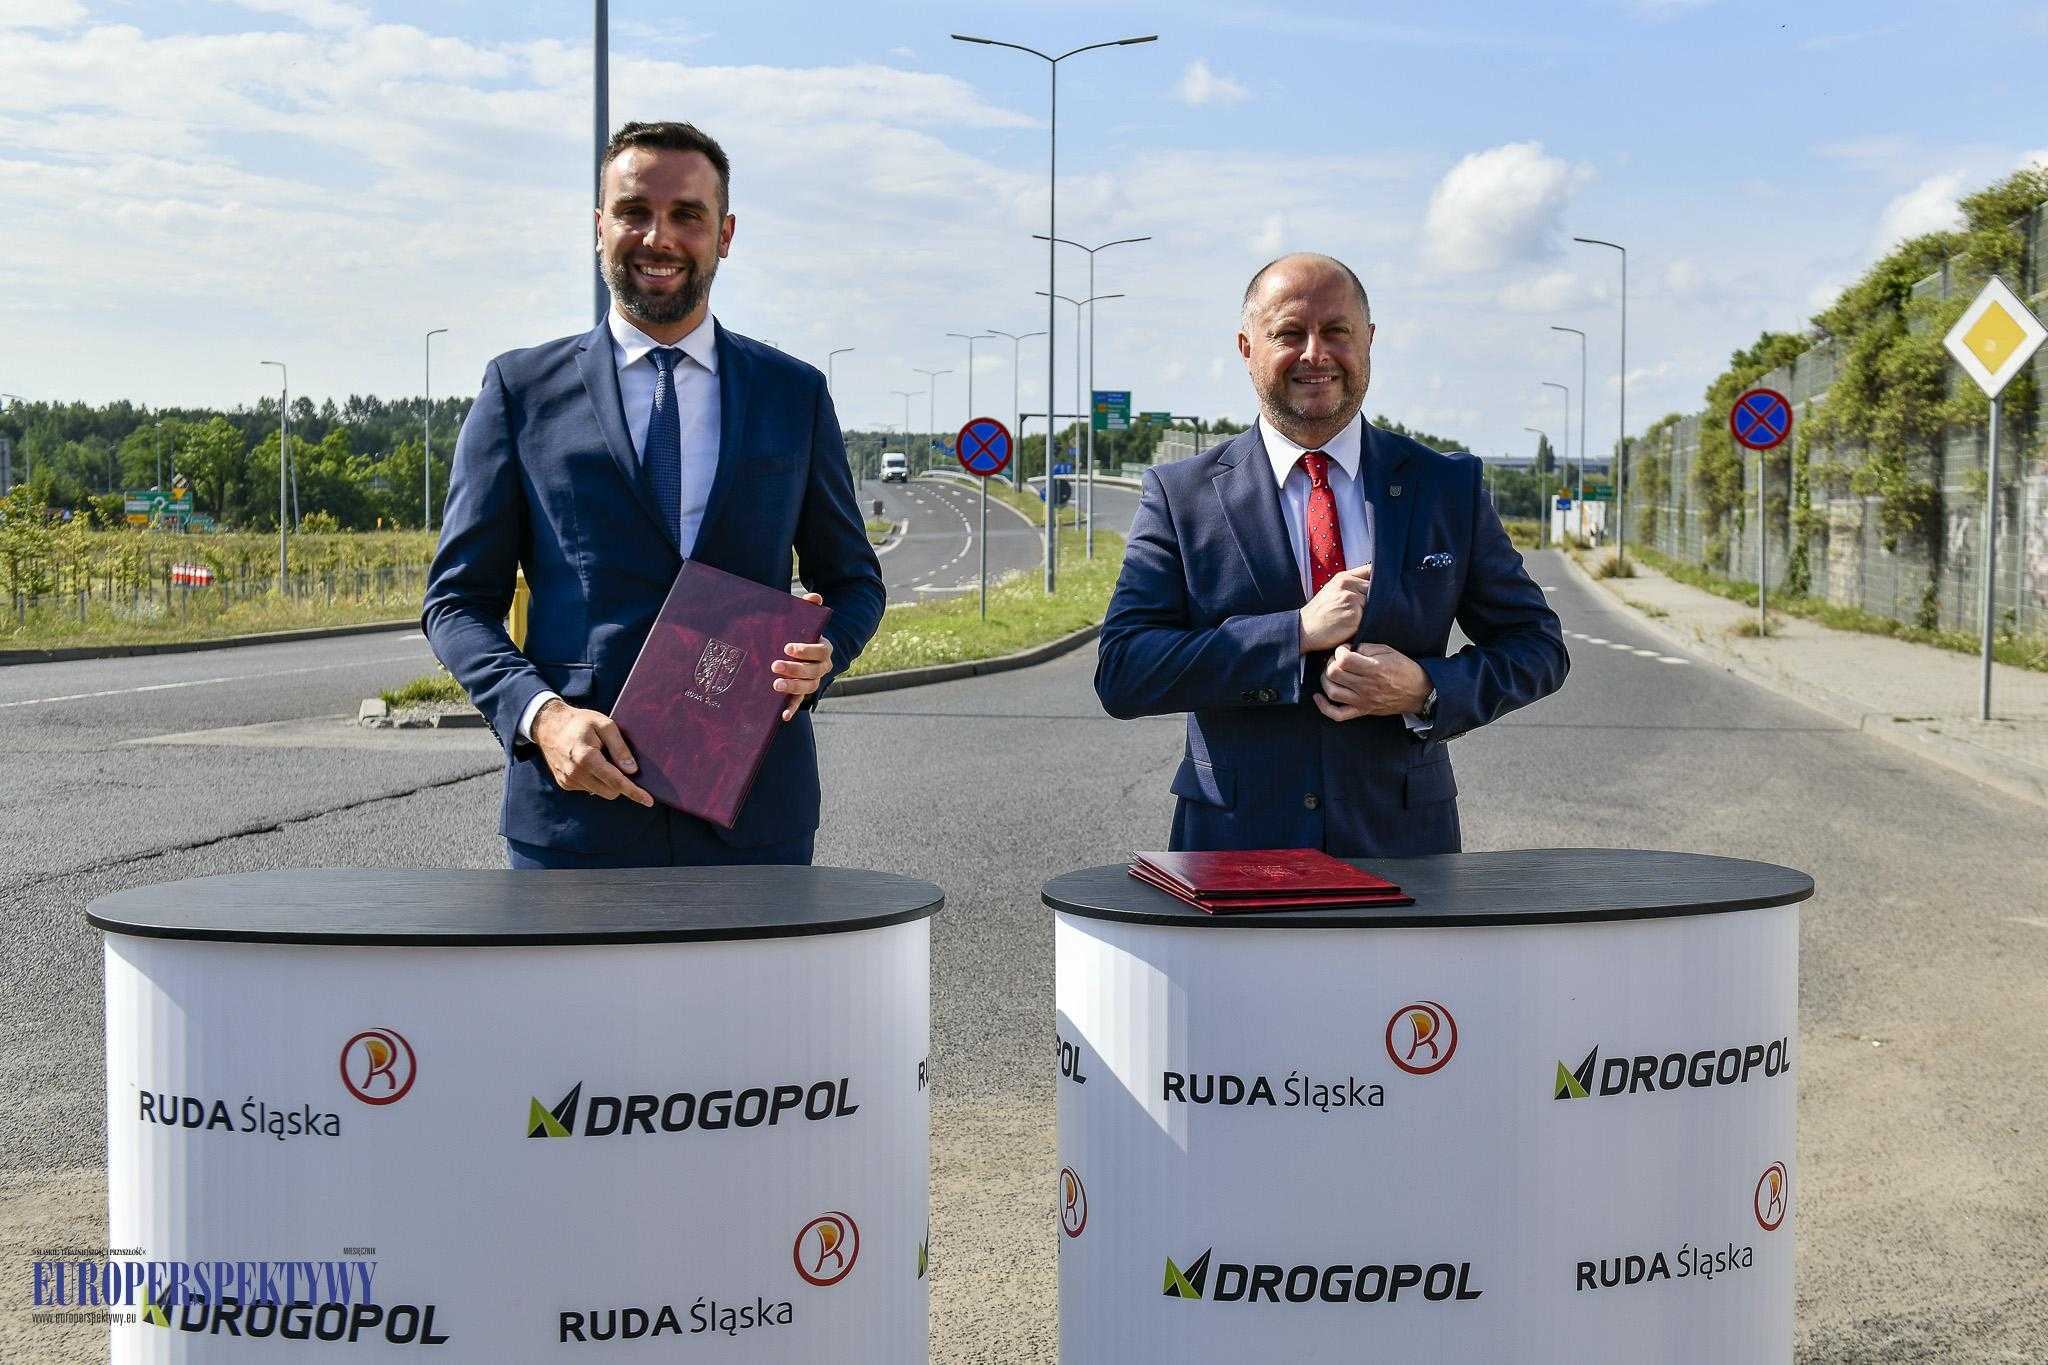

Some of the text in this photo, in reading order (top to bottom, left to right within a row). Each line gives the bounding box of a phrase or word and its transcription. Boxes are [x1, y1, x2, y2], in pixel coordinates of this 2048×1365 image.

[1163, 1070, 1385, 1113] RUDA Śląska
[1599, 1036, 1791, 1097] DROGOPOL
[140, 1090, 340, 1141] RUDA Śląska
[584, 1077, 860, 1137] DROGOPOL
[1213, 1262, 1484, 1303] DROGOPOL
[1576, 1242, 1753, 1292] RUDA Śląska
[180, 1292, 450, 1345] DROGOPOL
[559, 1296, 793, 1343] RUDA Śląska
